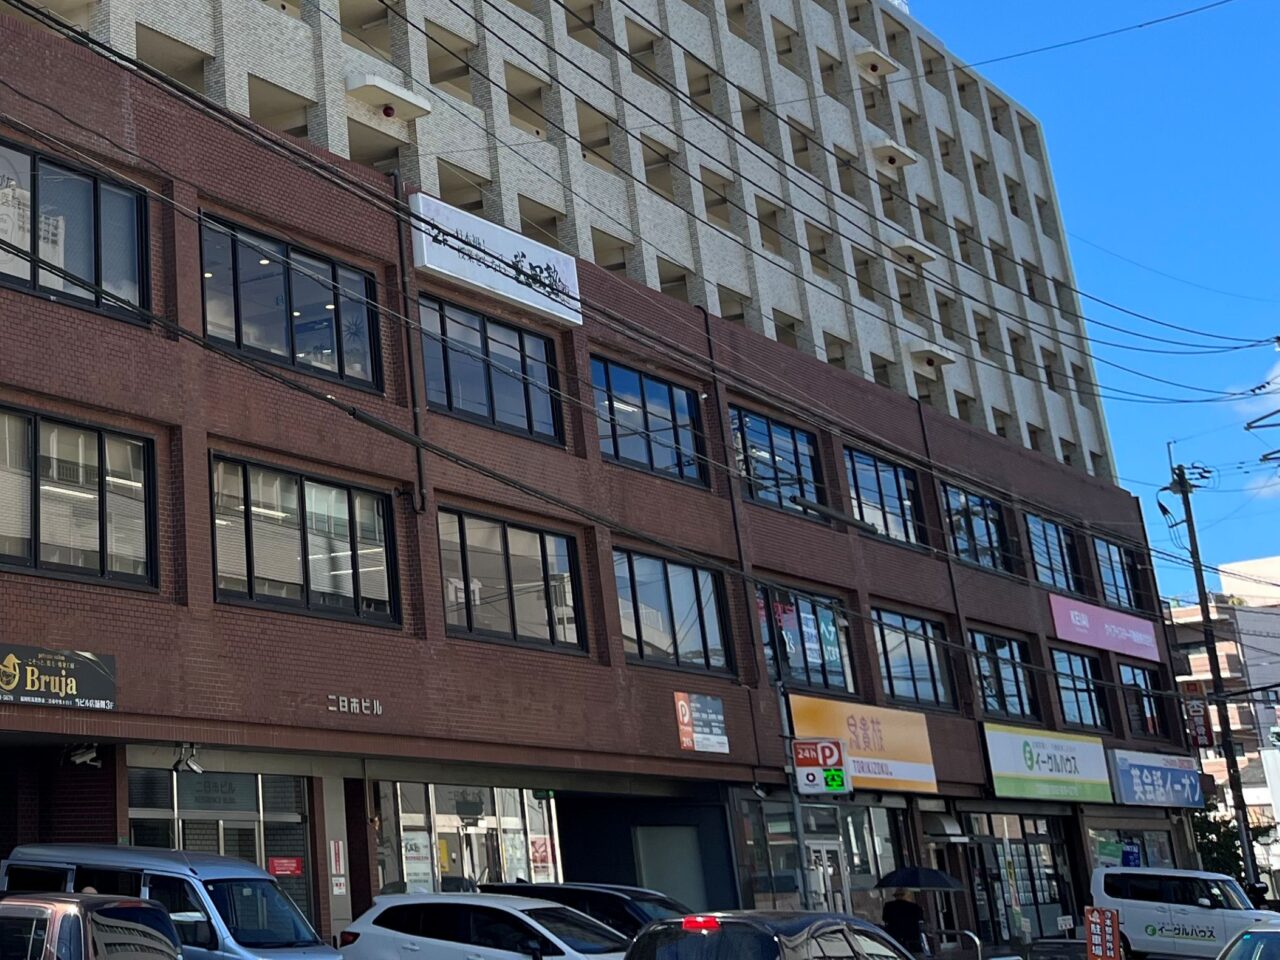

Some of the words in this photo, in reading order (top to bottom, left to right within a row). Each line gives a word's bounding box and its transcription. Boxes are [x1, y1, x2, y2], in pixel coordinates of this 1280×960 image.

[25, 666, 78, 697] Bruja
[327, 694, 383, 715] 二日市ビル
[797, 748, 817, 759] 24h
[1035, 751, 1080, 776] イーグルハウス
[1130, 766, 1201, 803] 英会話イーオン
[1157, 924, 1217, 940] イーグルハウス
